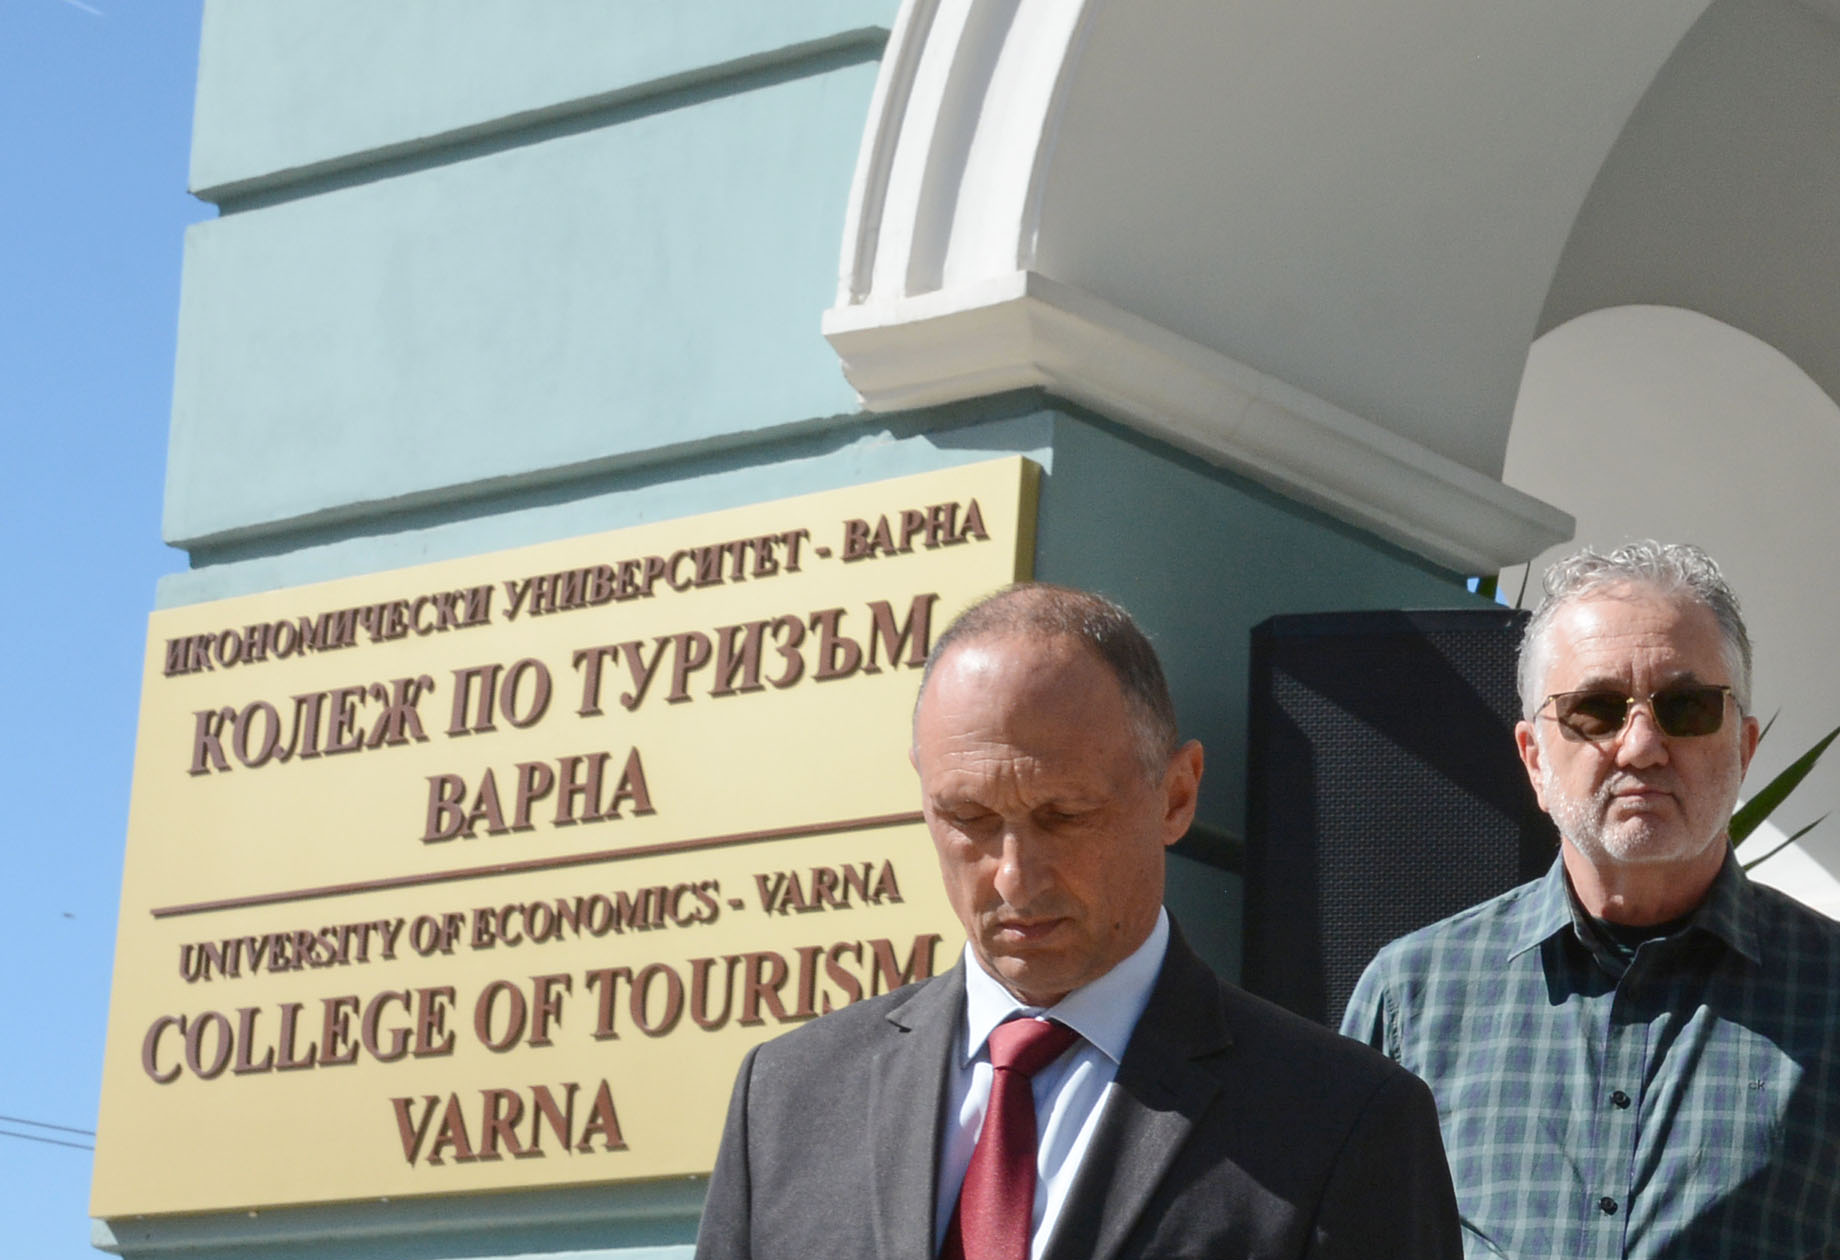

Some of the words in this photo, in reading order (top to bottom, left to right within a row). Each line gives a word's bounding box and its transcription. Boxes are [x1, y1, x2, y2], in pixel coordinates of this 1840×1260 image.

[163, 584, 495, 678] ИКОНОМИЧЕСКИ
[502, 528, 809, 621] УНИВЕРСИТЕТ
[814, 546, 833, 559] -
[841, 497, 990, 563] ВАРНА
[187, 674, 436, 777] КОЛЕЖ
[444, 657, 553, 738] ПО
[572, 592, 942, 718] ТУРИЗЪМ
[419, 745, 657, 845] ВАРНА
[179, 917, 406, 983] UNIVERSITY
[409, 911, 465, 956] OF
[470, 878, 721, 950] ECONOMICS
[728, 897, 746, 911] -
[753, 858, 905, 918] VARNA
[141, 985, 457, 1085] COLLEGE
[473, 973, 573, 1054] OF
[585, 933, 943, 1041] TOURISM
[389, 1078, 631, 1169] VARNA
